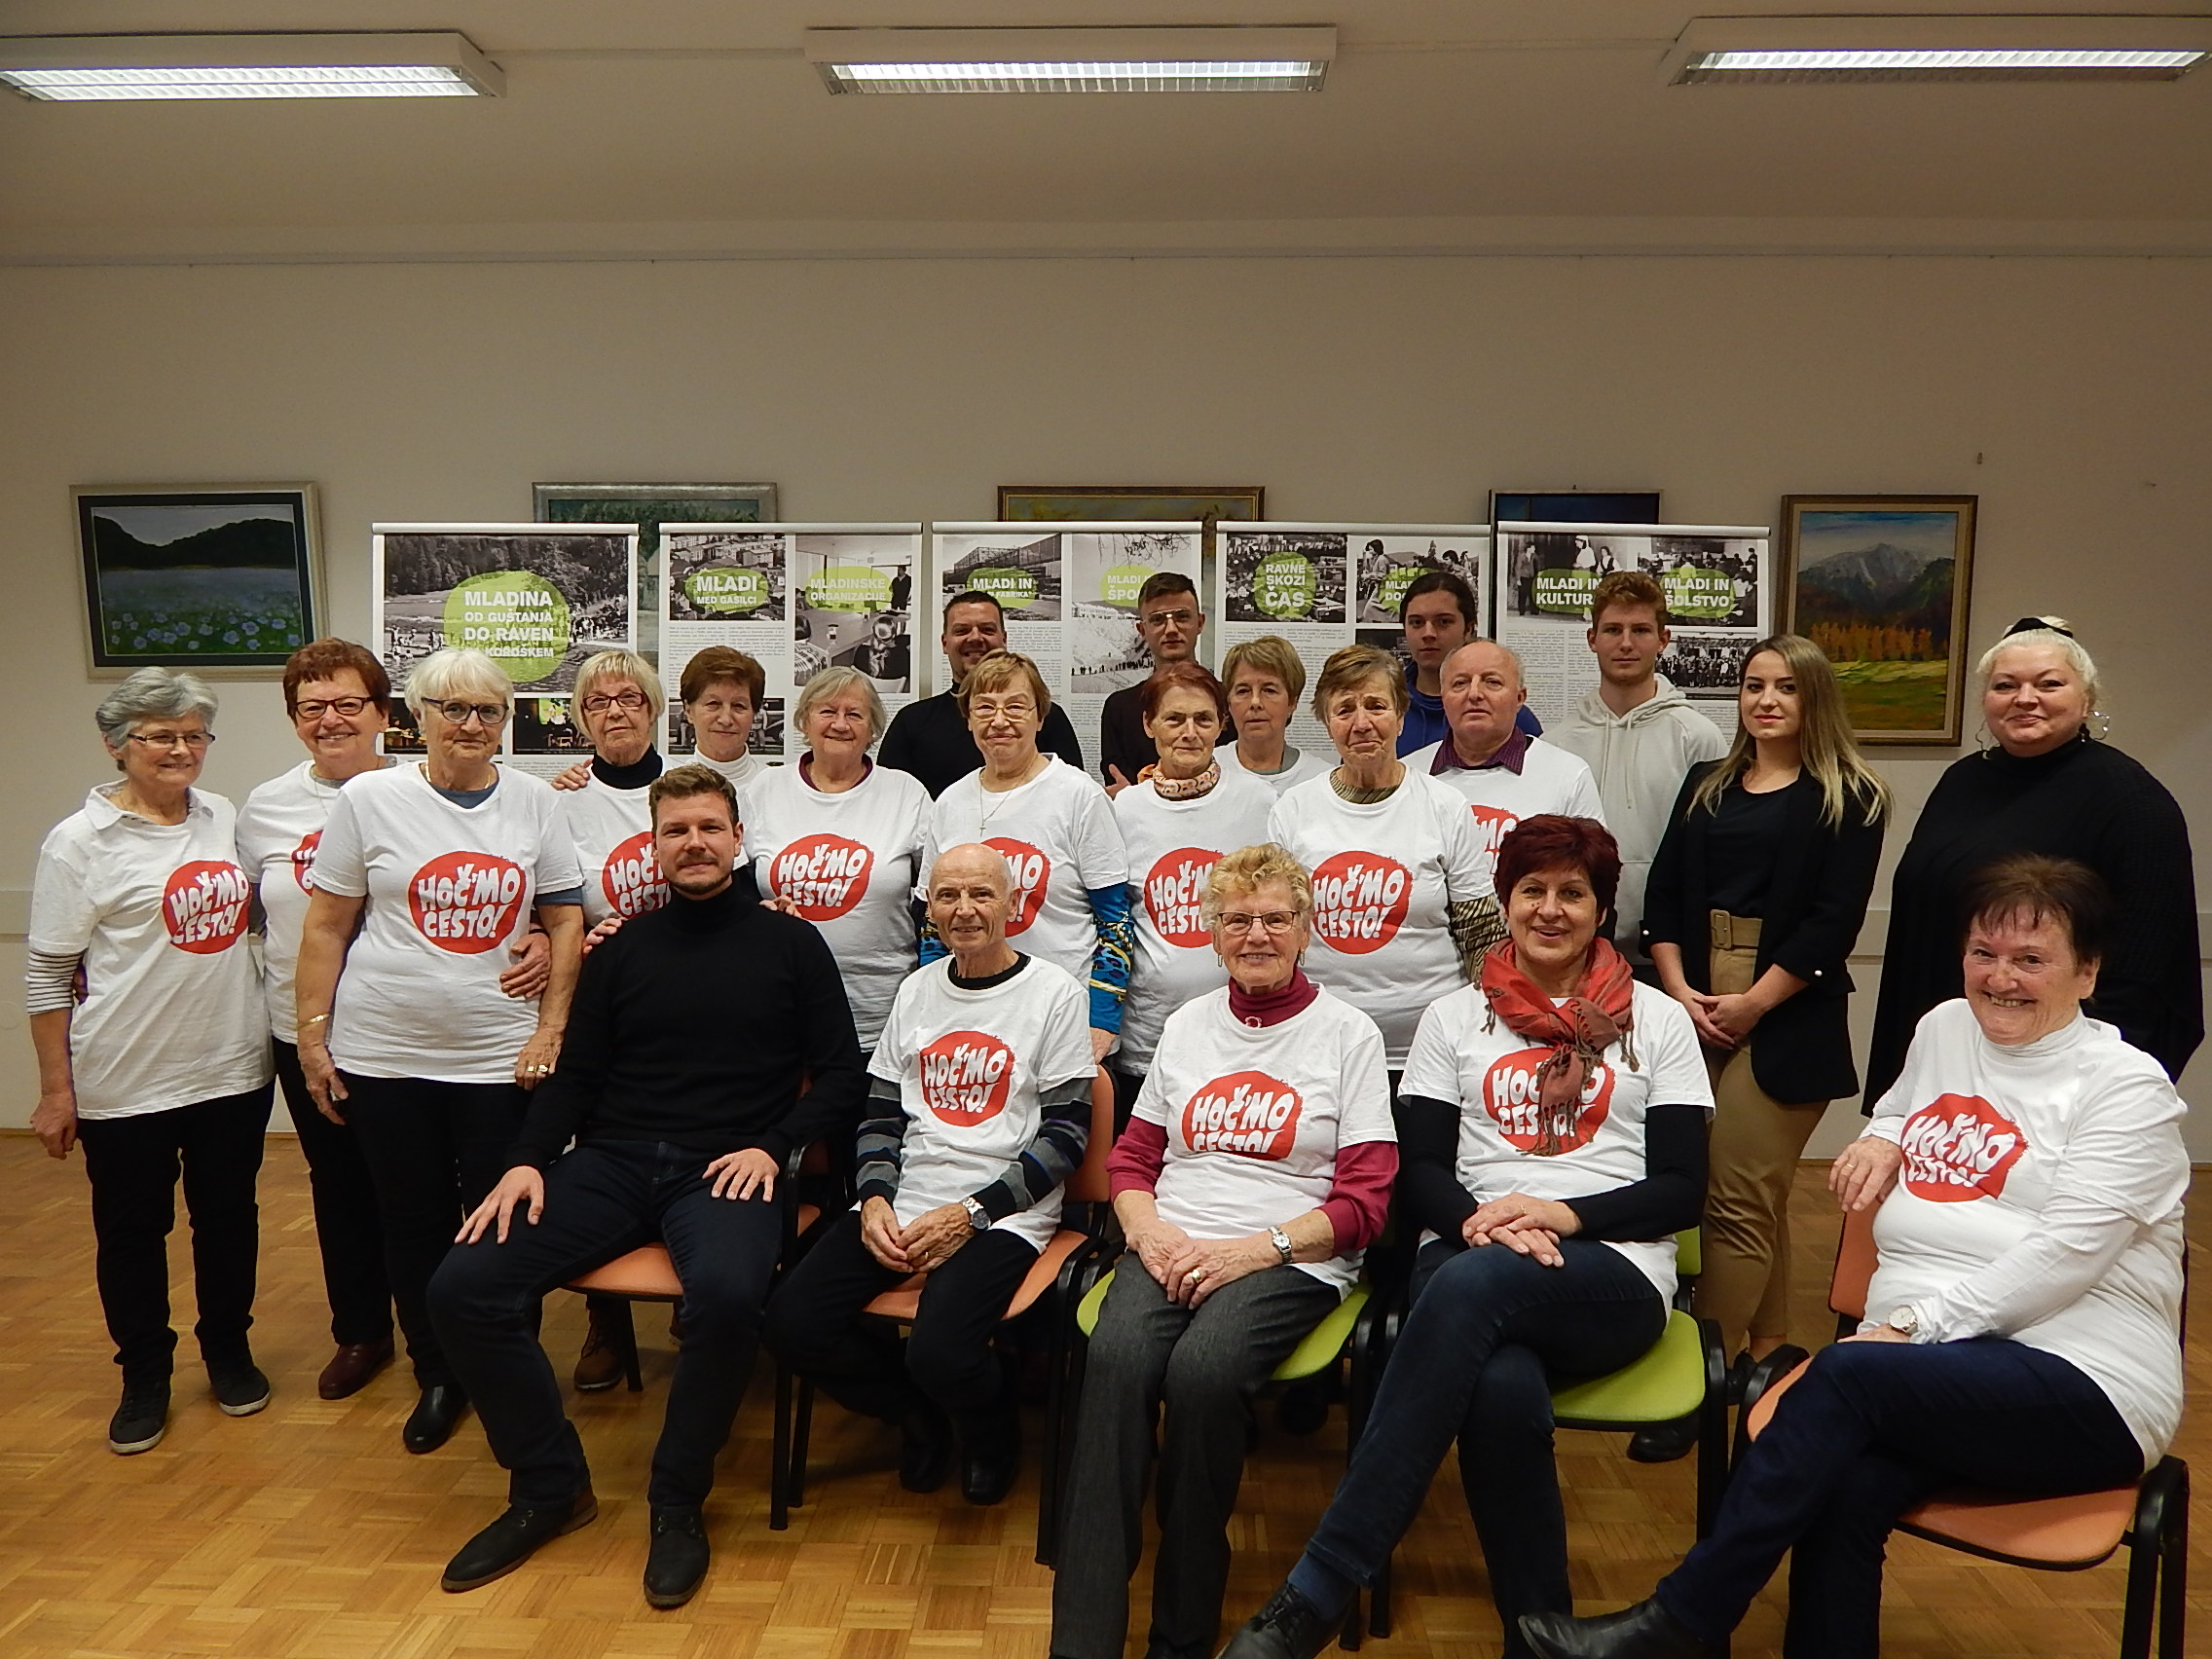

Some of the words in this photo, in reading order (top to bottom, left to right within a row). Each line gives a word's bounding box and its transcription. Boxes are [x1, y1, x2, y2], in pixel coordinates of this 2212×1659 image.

[1266, 564, 1306, 574] RAVNE
[696, 575, 757, 592] MLADI
[810, 578, 886, 589] MLADINSKE
[973, 577, 1014, 590] MLADI
[1017, 577, 1033, 590] IN
[1108, 574, 1141, 584] MLADI
[1266, 574, 1306, 586] SKOZI
[1536, 577, 1583, 591] MLADI
[1664, 577, 1711, 591] MLADI
[1714, 578, 1730, 591] IN
[463, 590, 554, 607] MLADINA
[810, 592, 886, 601] ORGANIZACIJE
[1107, 585, 1139, 601] ŠPO
[1266, 585, 1306, 608] ČAS
[1535, 592, 1595, 606] KULTUR
[1664, 590, 1730, 608] ŠOLSTVO
[696, 596, 718, 605] MED
[720, 596, 757, 605] GASILCI
[463, 611, 484, 622] OD
[488, 608, 554, 623] GUŠTANJA
[463, 626, 491, 642] DO
[496, 627, 554, 642] RAVEN
[485, 644, 554, 658] KOROŠKEM
[171, 899, 244, 944] CESTO!
[423, 903, 514, 939] CESTO!
[1316, 904, 1398, 940] CESTO!
[929, 1082, 1001, 1114] CESTO!
